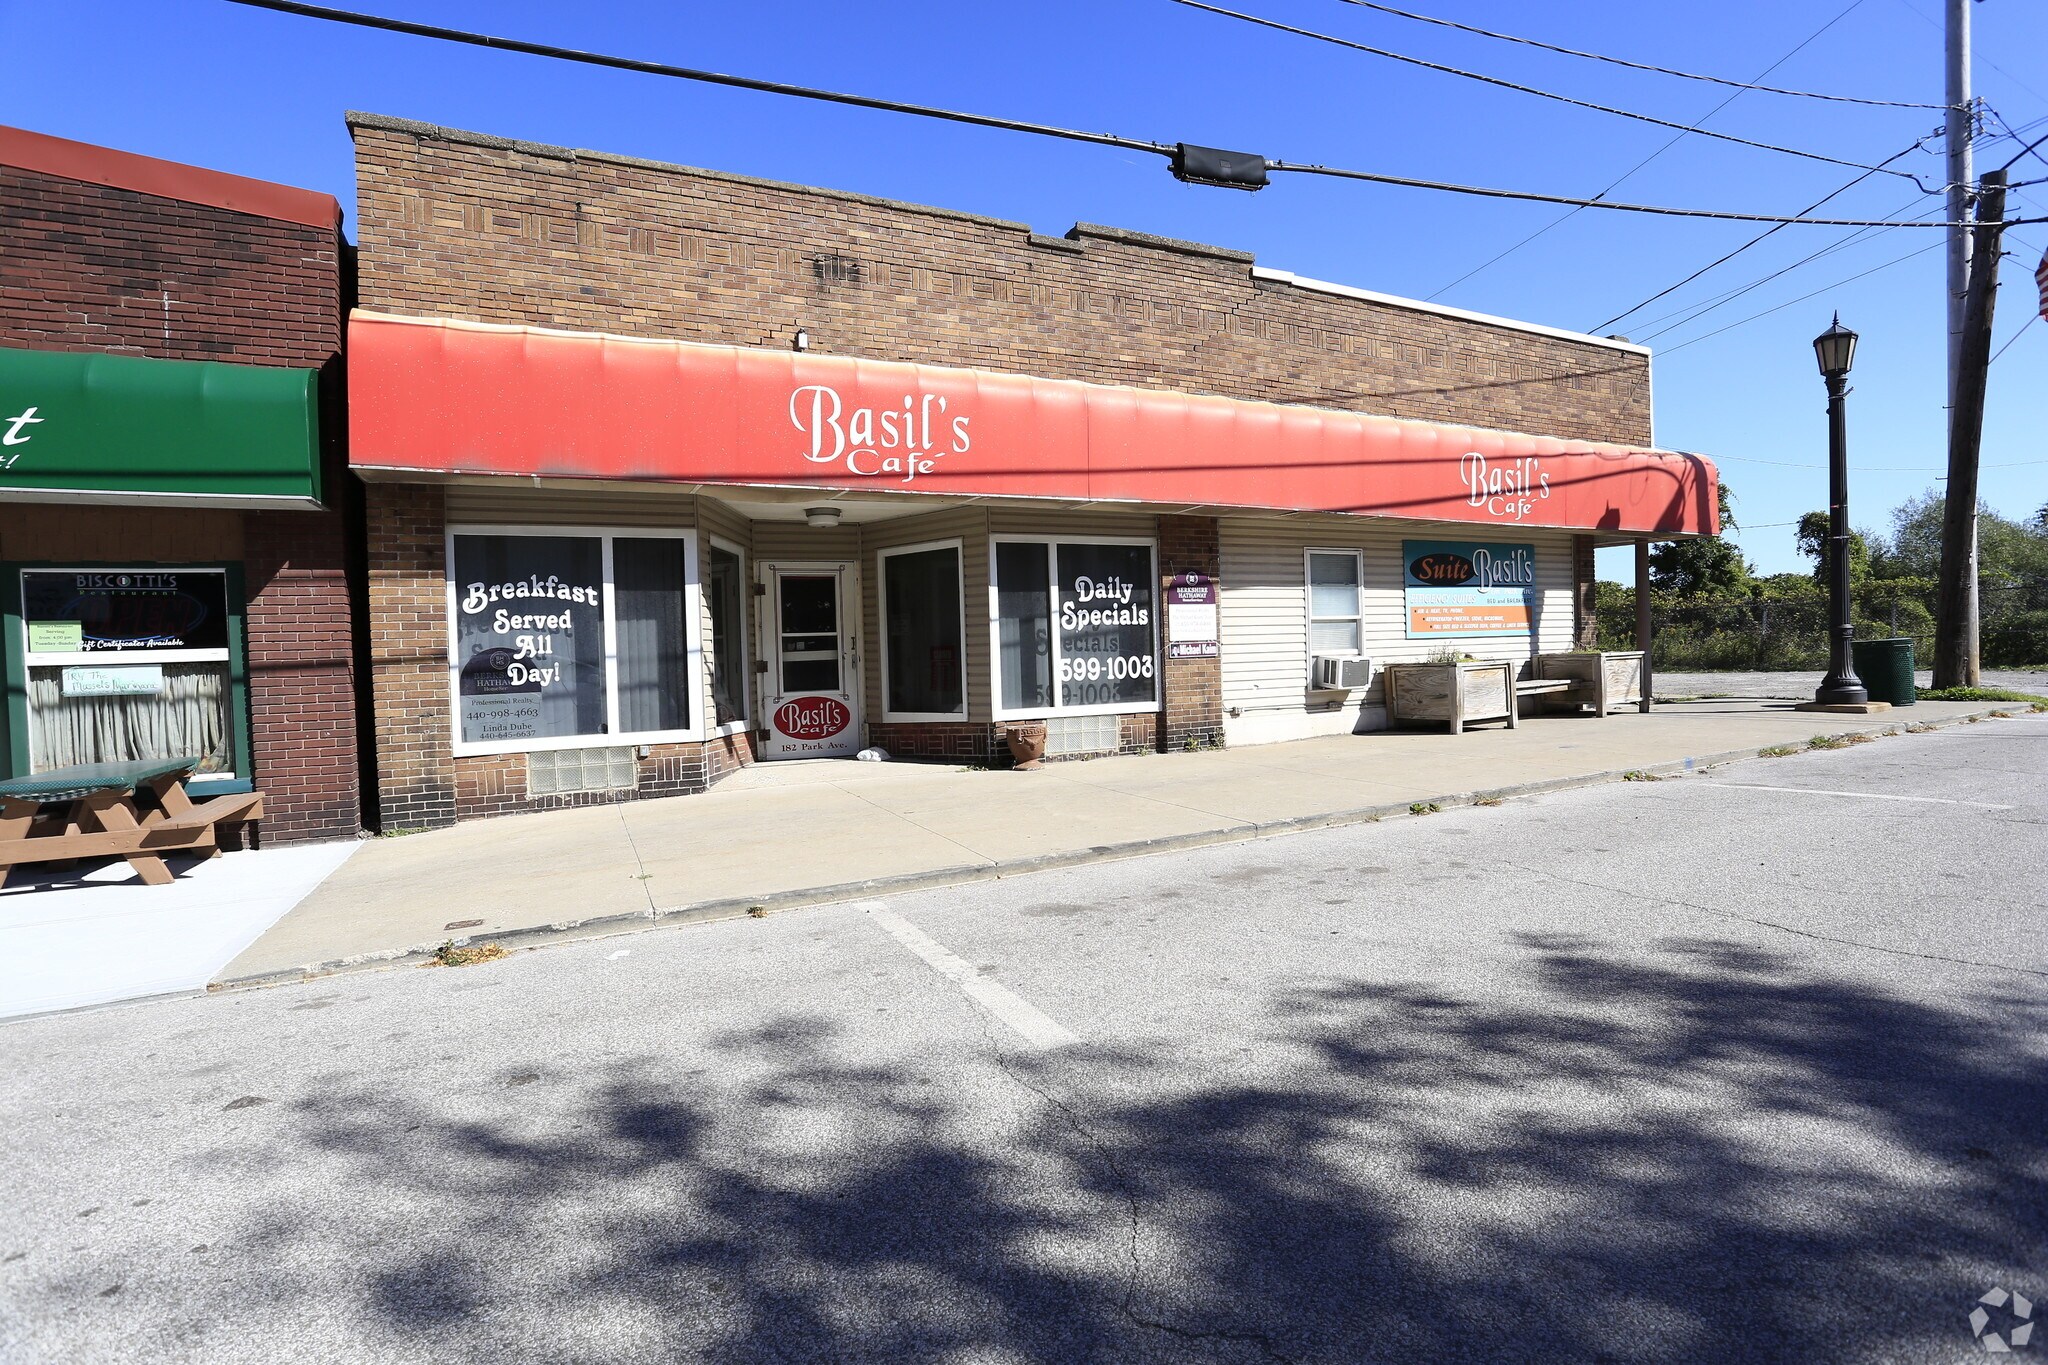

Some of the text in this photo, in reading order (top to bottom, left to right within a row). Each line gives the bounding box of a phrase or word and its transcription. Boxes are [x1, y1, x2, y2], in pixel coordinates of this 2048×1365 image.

[788, 385, 970, 463] Basil's
[846, 448, 946, 483] Café
[1460, 452, 1550, 507] Basil's
[1487, 496, 1538, 520] Café
[76, 574, 177, 588] BISCOTTI'S
[1419, 548, 1532, 593] Suite Basil's
[462, 574, 599, 614] Breakfast
[1074, 575, 1134, 604] Daily
[493, 608, 572, 634] Served
[1061, 601, 1149, 631] Specials
[77, 638, 184, 651] Gift Certificates Available
[513, 634, 552, 660] All
[507, 661, 560, 687] Day!
[1061, 654, 1154, 682] 599-1003
[466, 707, 539, 720] 440-998-4663
[471, 698, 511, 706] Professional
[483, 722, 533, 732] Linda Dube
[781, 701, 842, 733] Basil's
[480, 729, 536, 740] 440-645-6637
[782, 741, 848, 752] 182 Park Ave.
